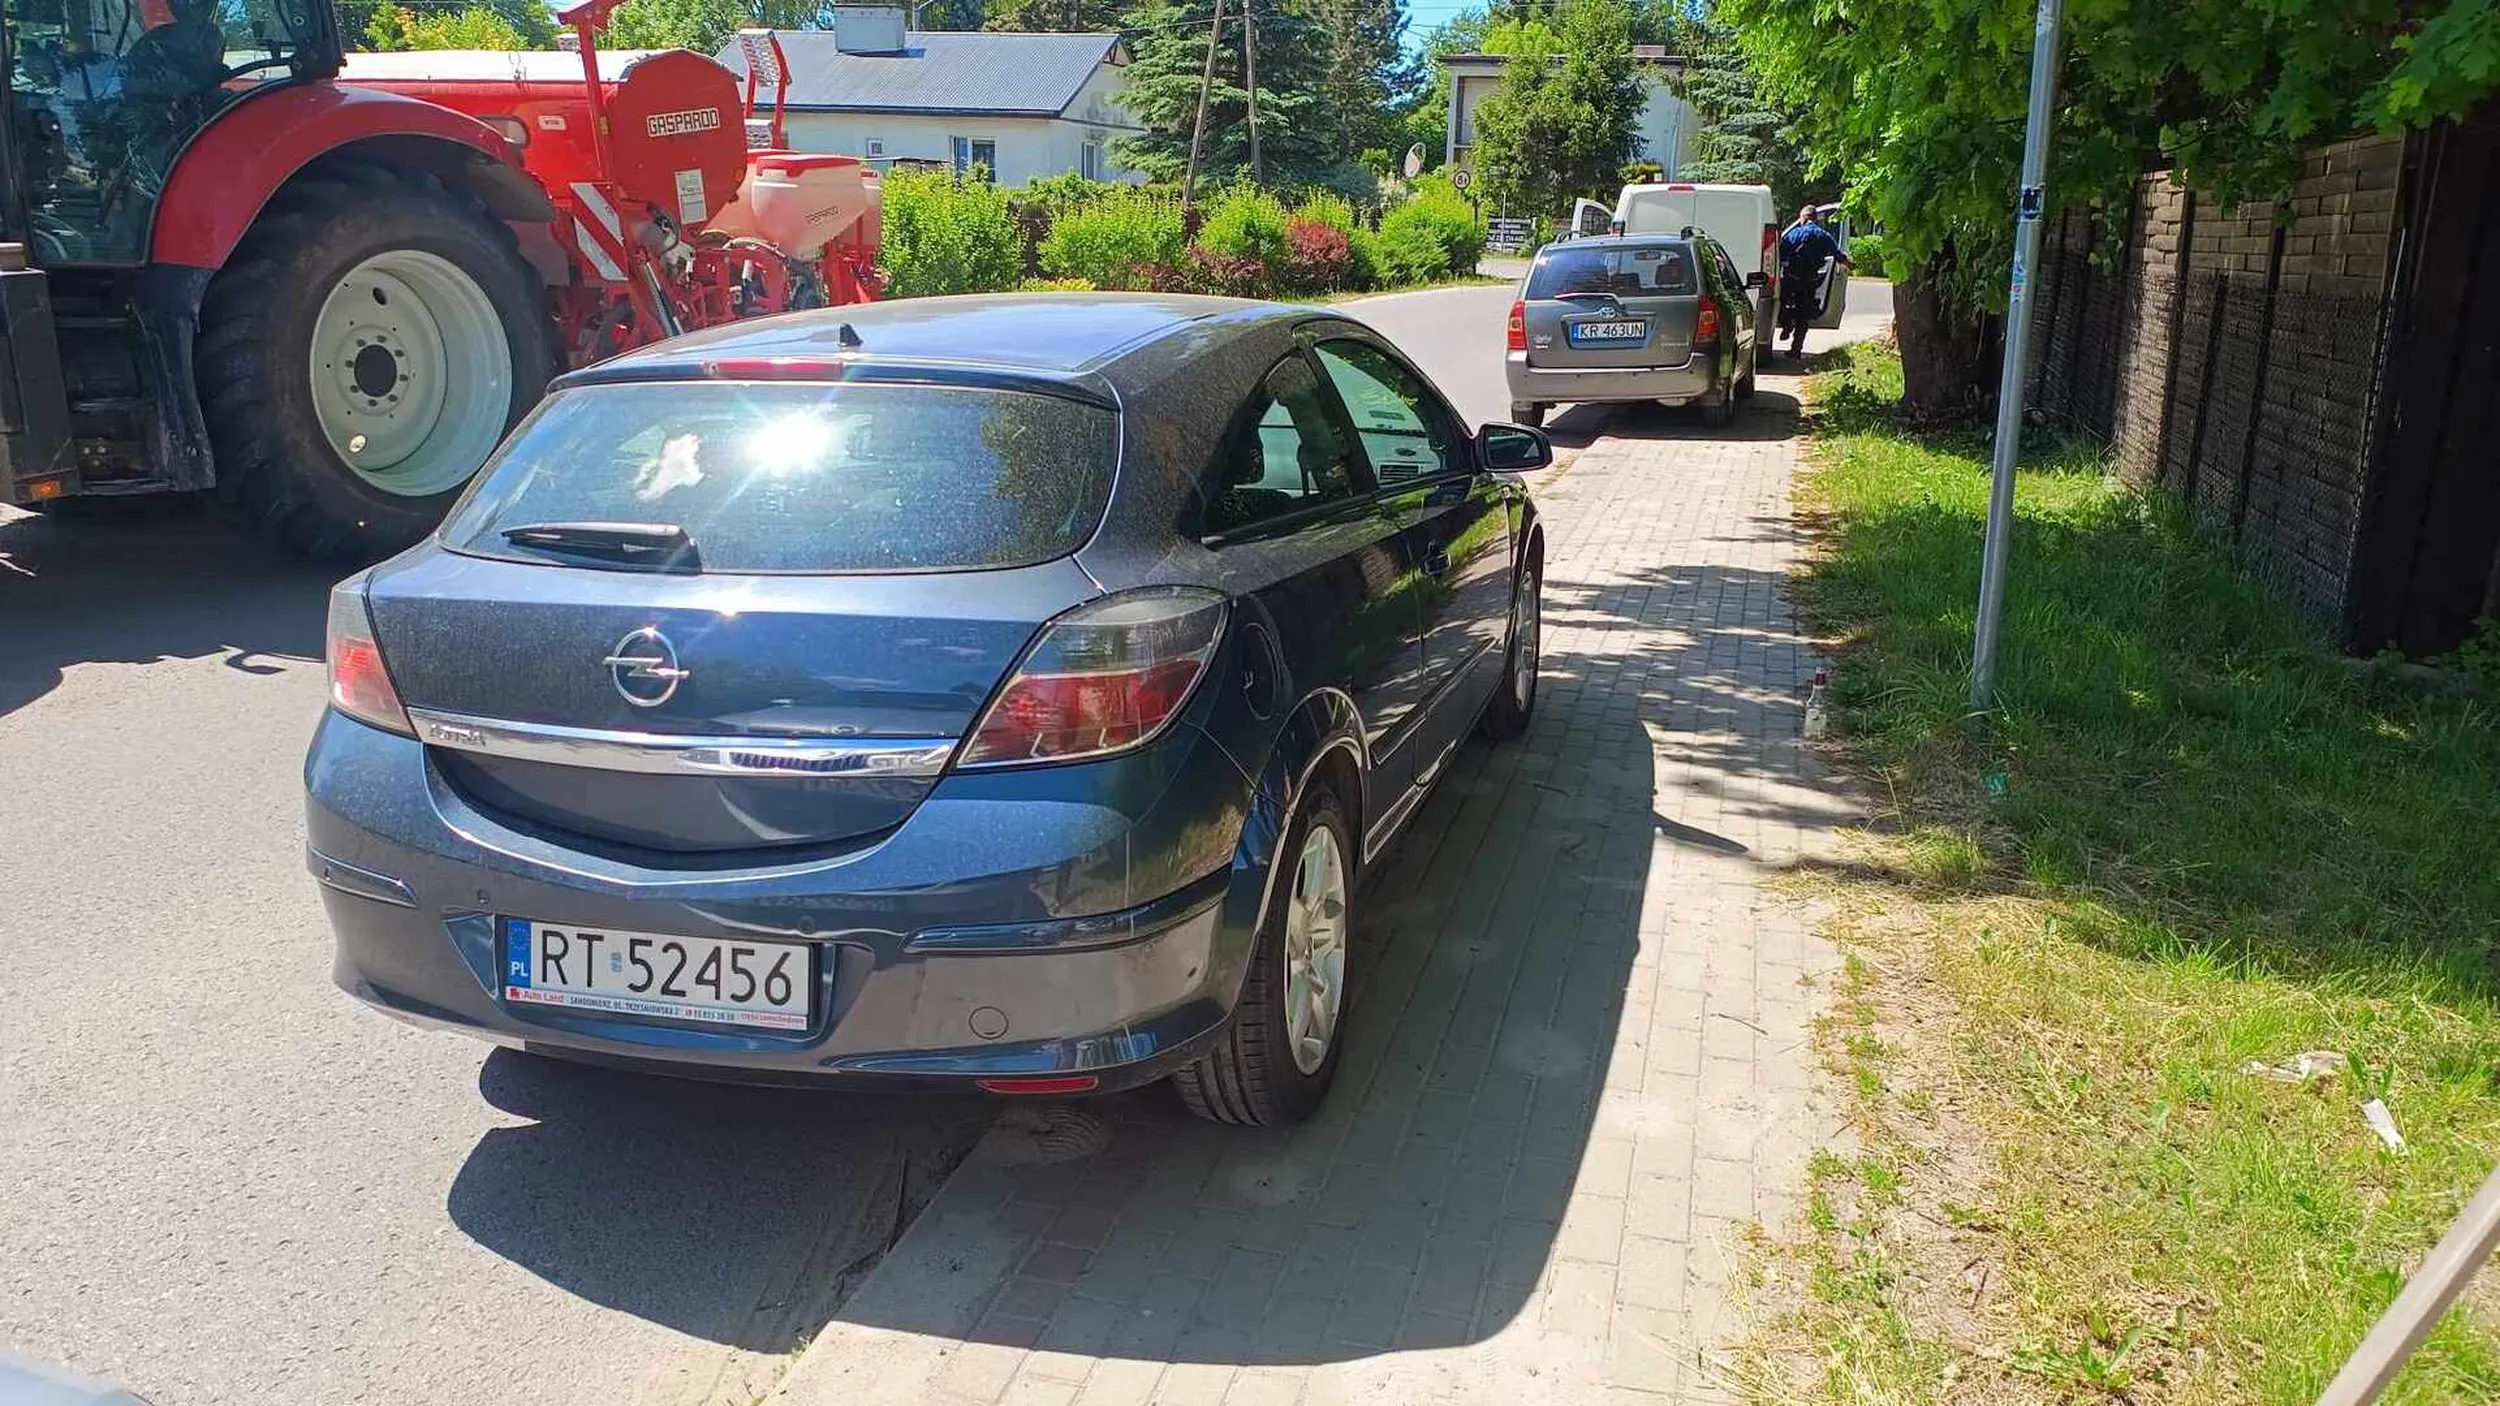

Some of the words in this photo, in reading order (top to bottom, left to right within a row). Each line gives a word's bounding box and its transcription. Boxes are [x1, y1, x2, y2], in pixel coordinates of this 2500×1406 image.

[648, 109, 718, 135] GASPARDO
[1580, 325, 1599, 338] KR
[1603, 322, 1643, 338] 463UN
[511, 961, 529, 977] PL
[541, 930, 604, 988] RT
[627, 938, 792, 1006] 52456
